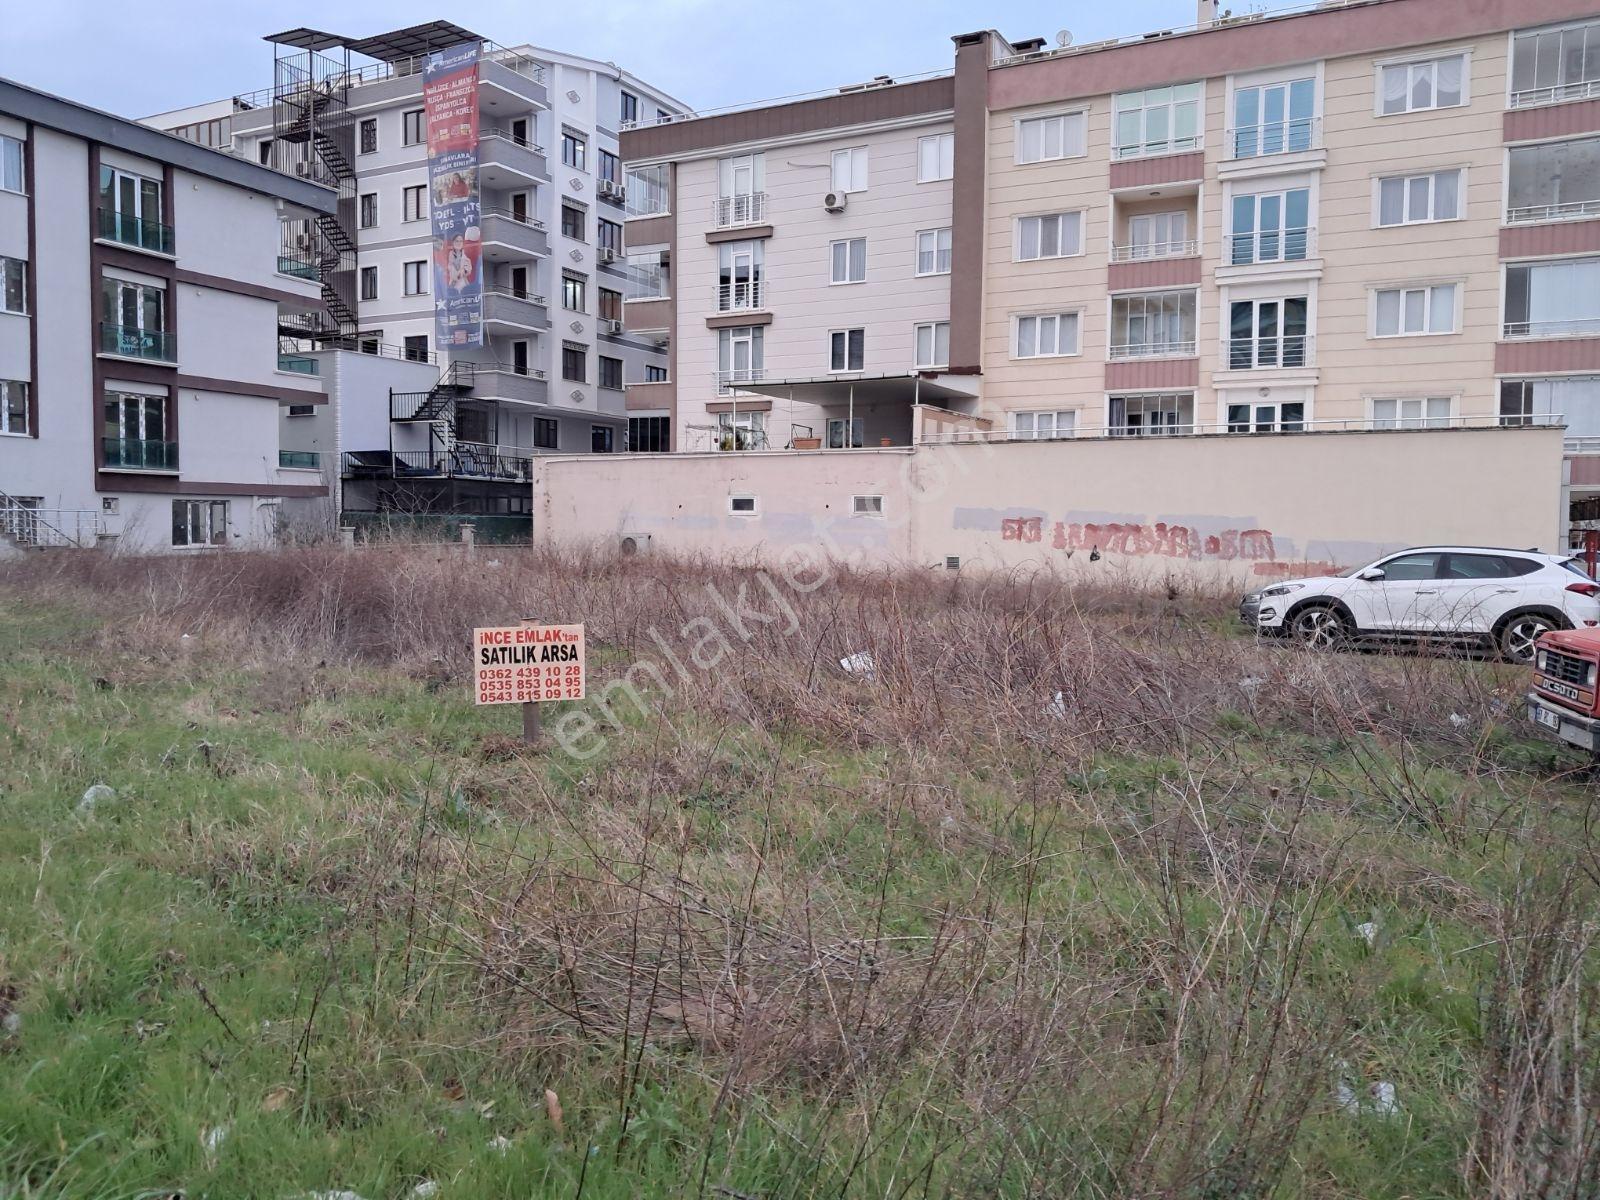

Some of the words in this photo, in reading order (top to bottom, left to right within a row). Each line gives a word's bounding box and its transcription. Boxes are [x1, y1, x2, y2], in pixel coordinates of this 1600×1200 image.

[481, 645, 536, 665] SATILIK
[541, 644, 578, 663] ARSA
[479, 669, 512, 680] 0362
[516, 667, 541, 678] 439
[546, 666, 561, 677] 10
[565, 665, 580, 676] 28
[479, 680, 512, 691] 0535
[516, 679, 541, 690] 853
[545, 678, 561, 688] 04
[565, 677, 581, 687] 95
[480, 691, 513, 703] 0543
[517, 690, 541, 701] 815
[545, 689, 561, 699] 09
[566, 688, 581, 698] 12
